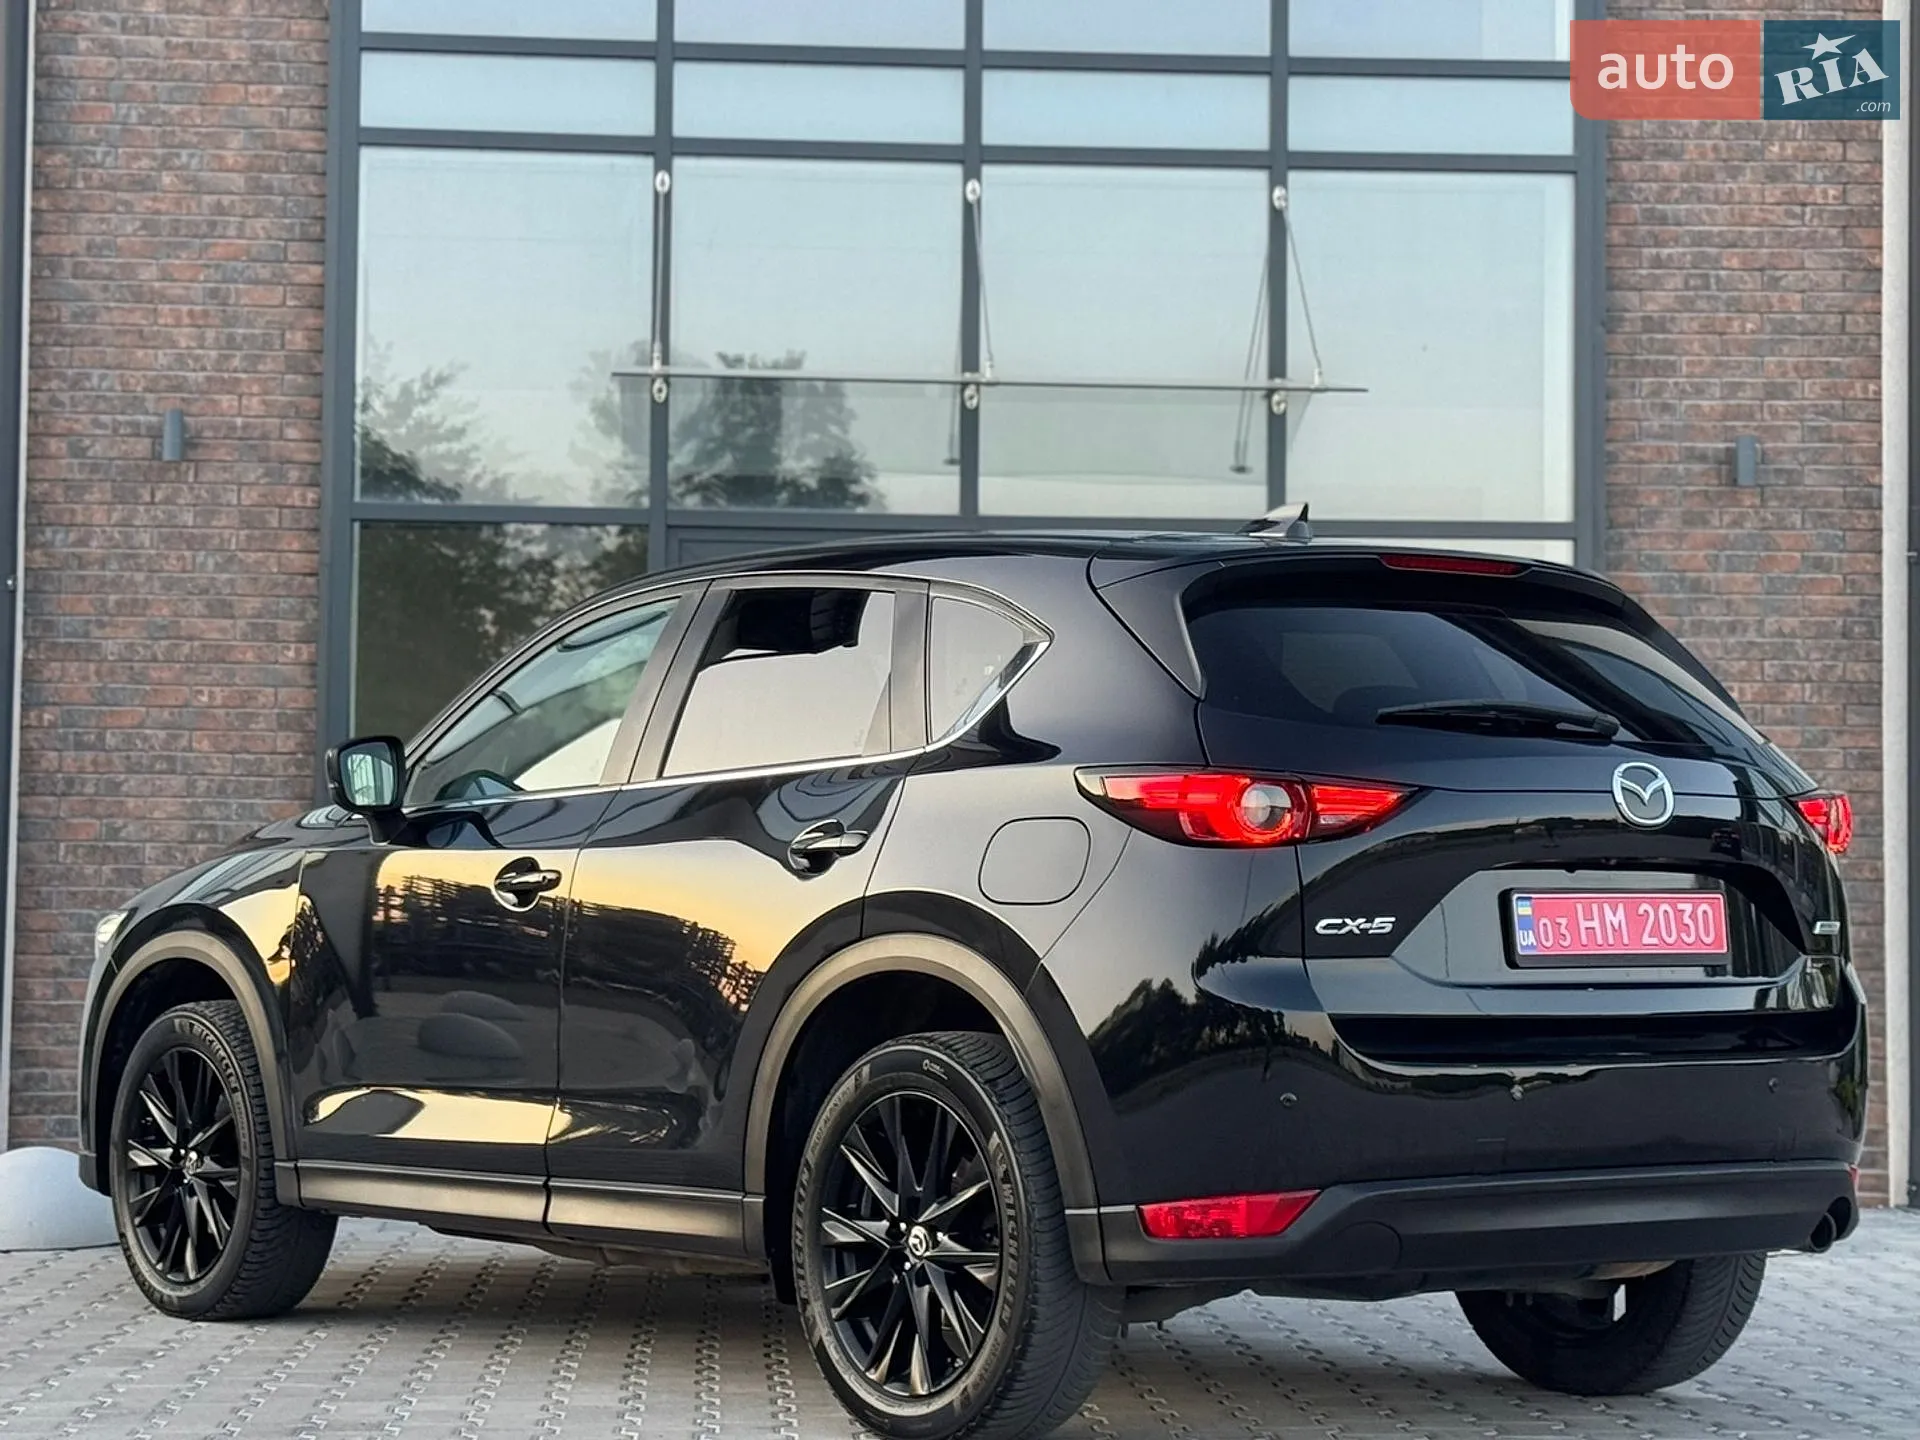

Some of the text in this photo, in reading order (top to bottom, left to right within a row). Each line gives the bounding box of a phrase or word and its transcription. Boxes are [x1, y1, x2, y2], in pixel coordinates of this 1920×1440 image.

[1315, 916, 1397, 935] CX-5
[1539, 902, 1717, 949] 03 HM 2030
[1519, 930, 1537, 946] UA
